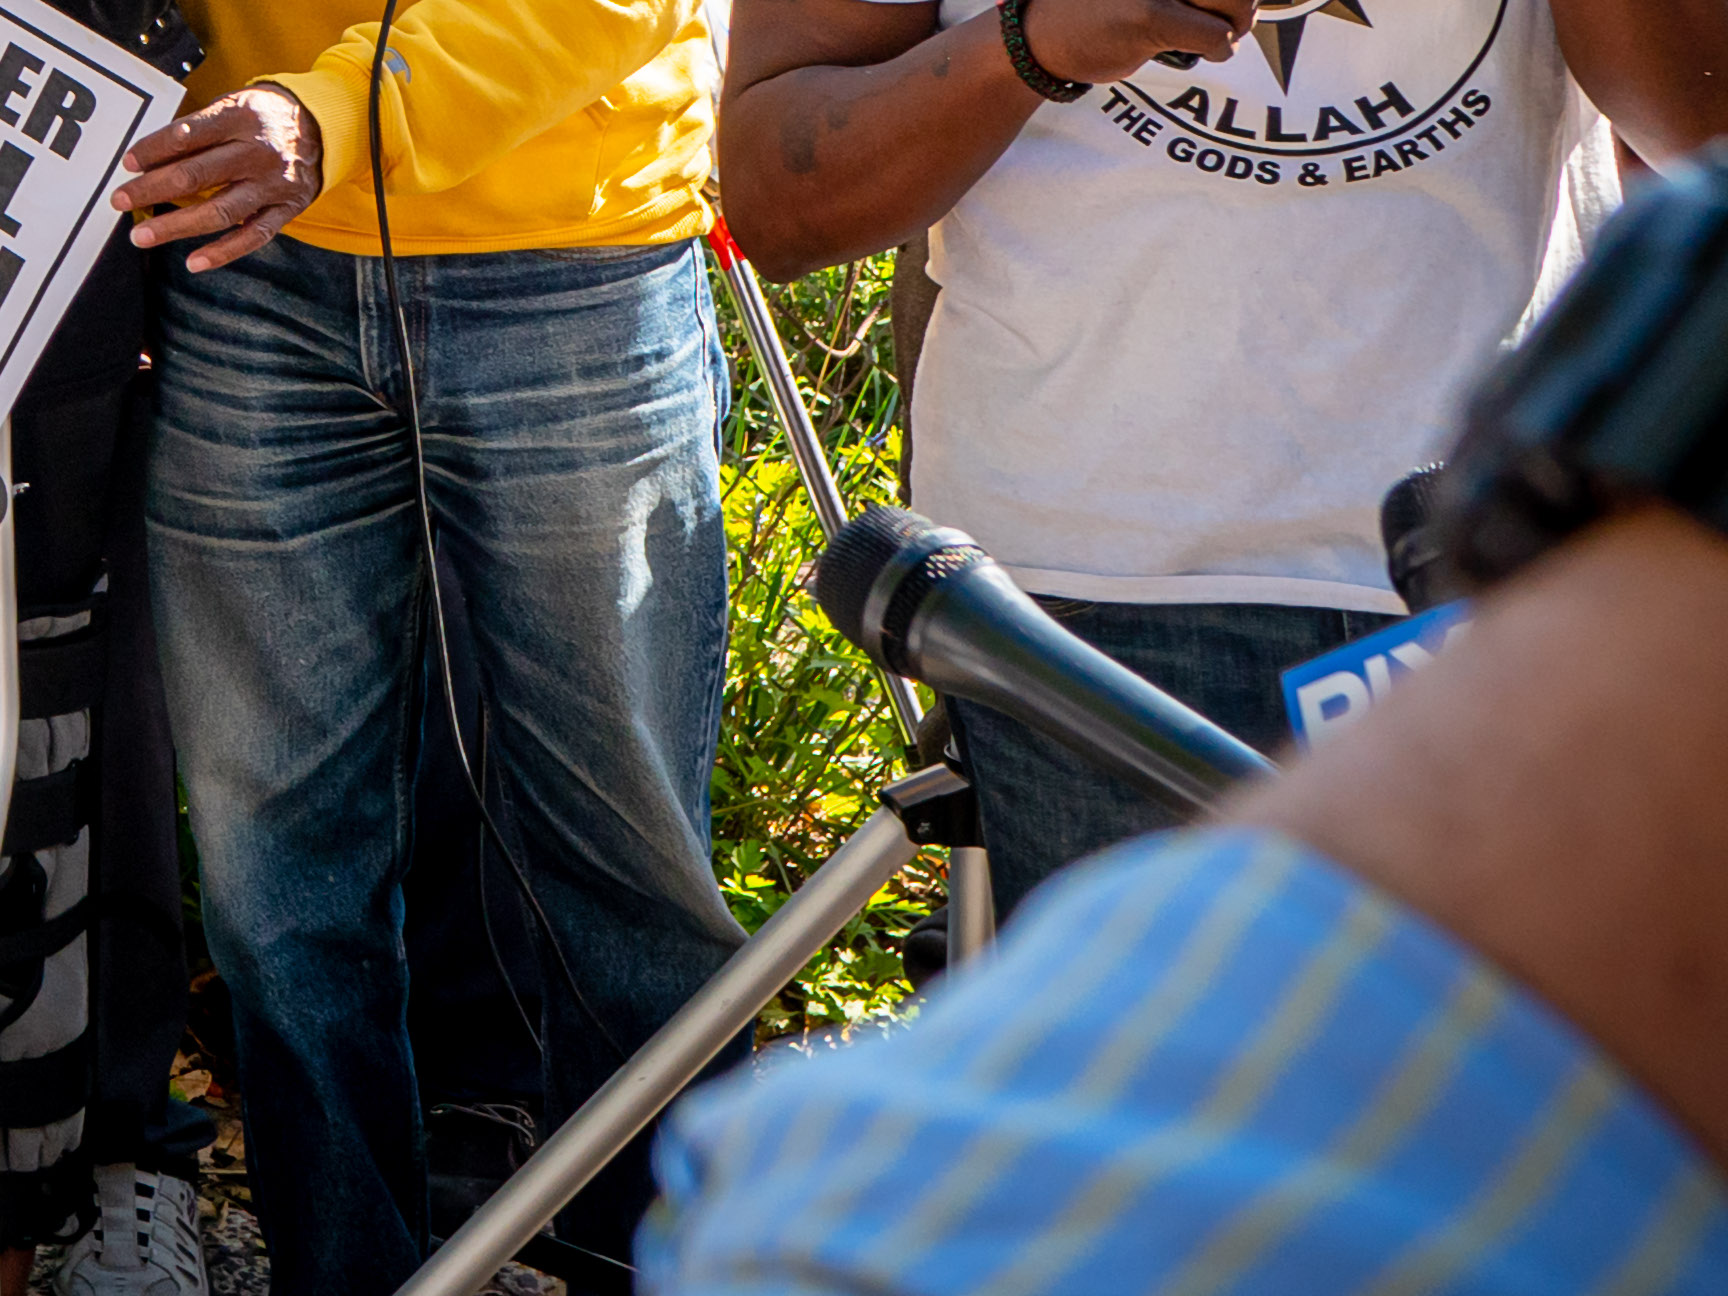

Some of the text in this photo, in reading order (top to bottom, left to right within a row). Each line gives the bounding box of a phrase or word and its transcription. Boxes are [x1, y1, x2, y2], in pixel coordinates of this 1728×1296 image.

[1100, 86, 1493, 187] THE GODS & EARTHS
[1168, 81, 1416, 144] ALLAH
